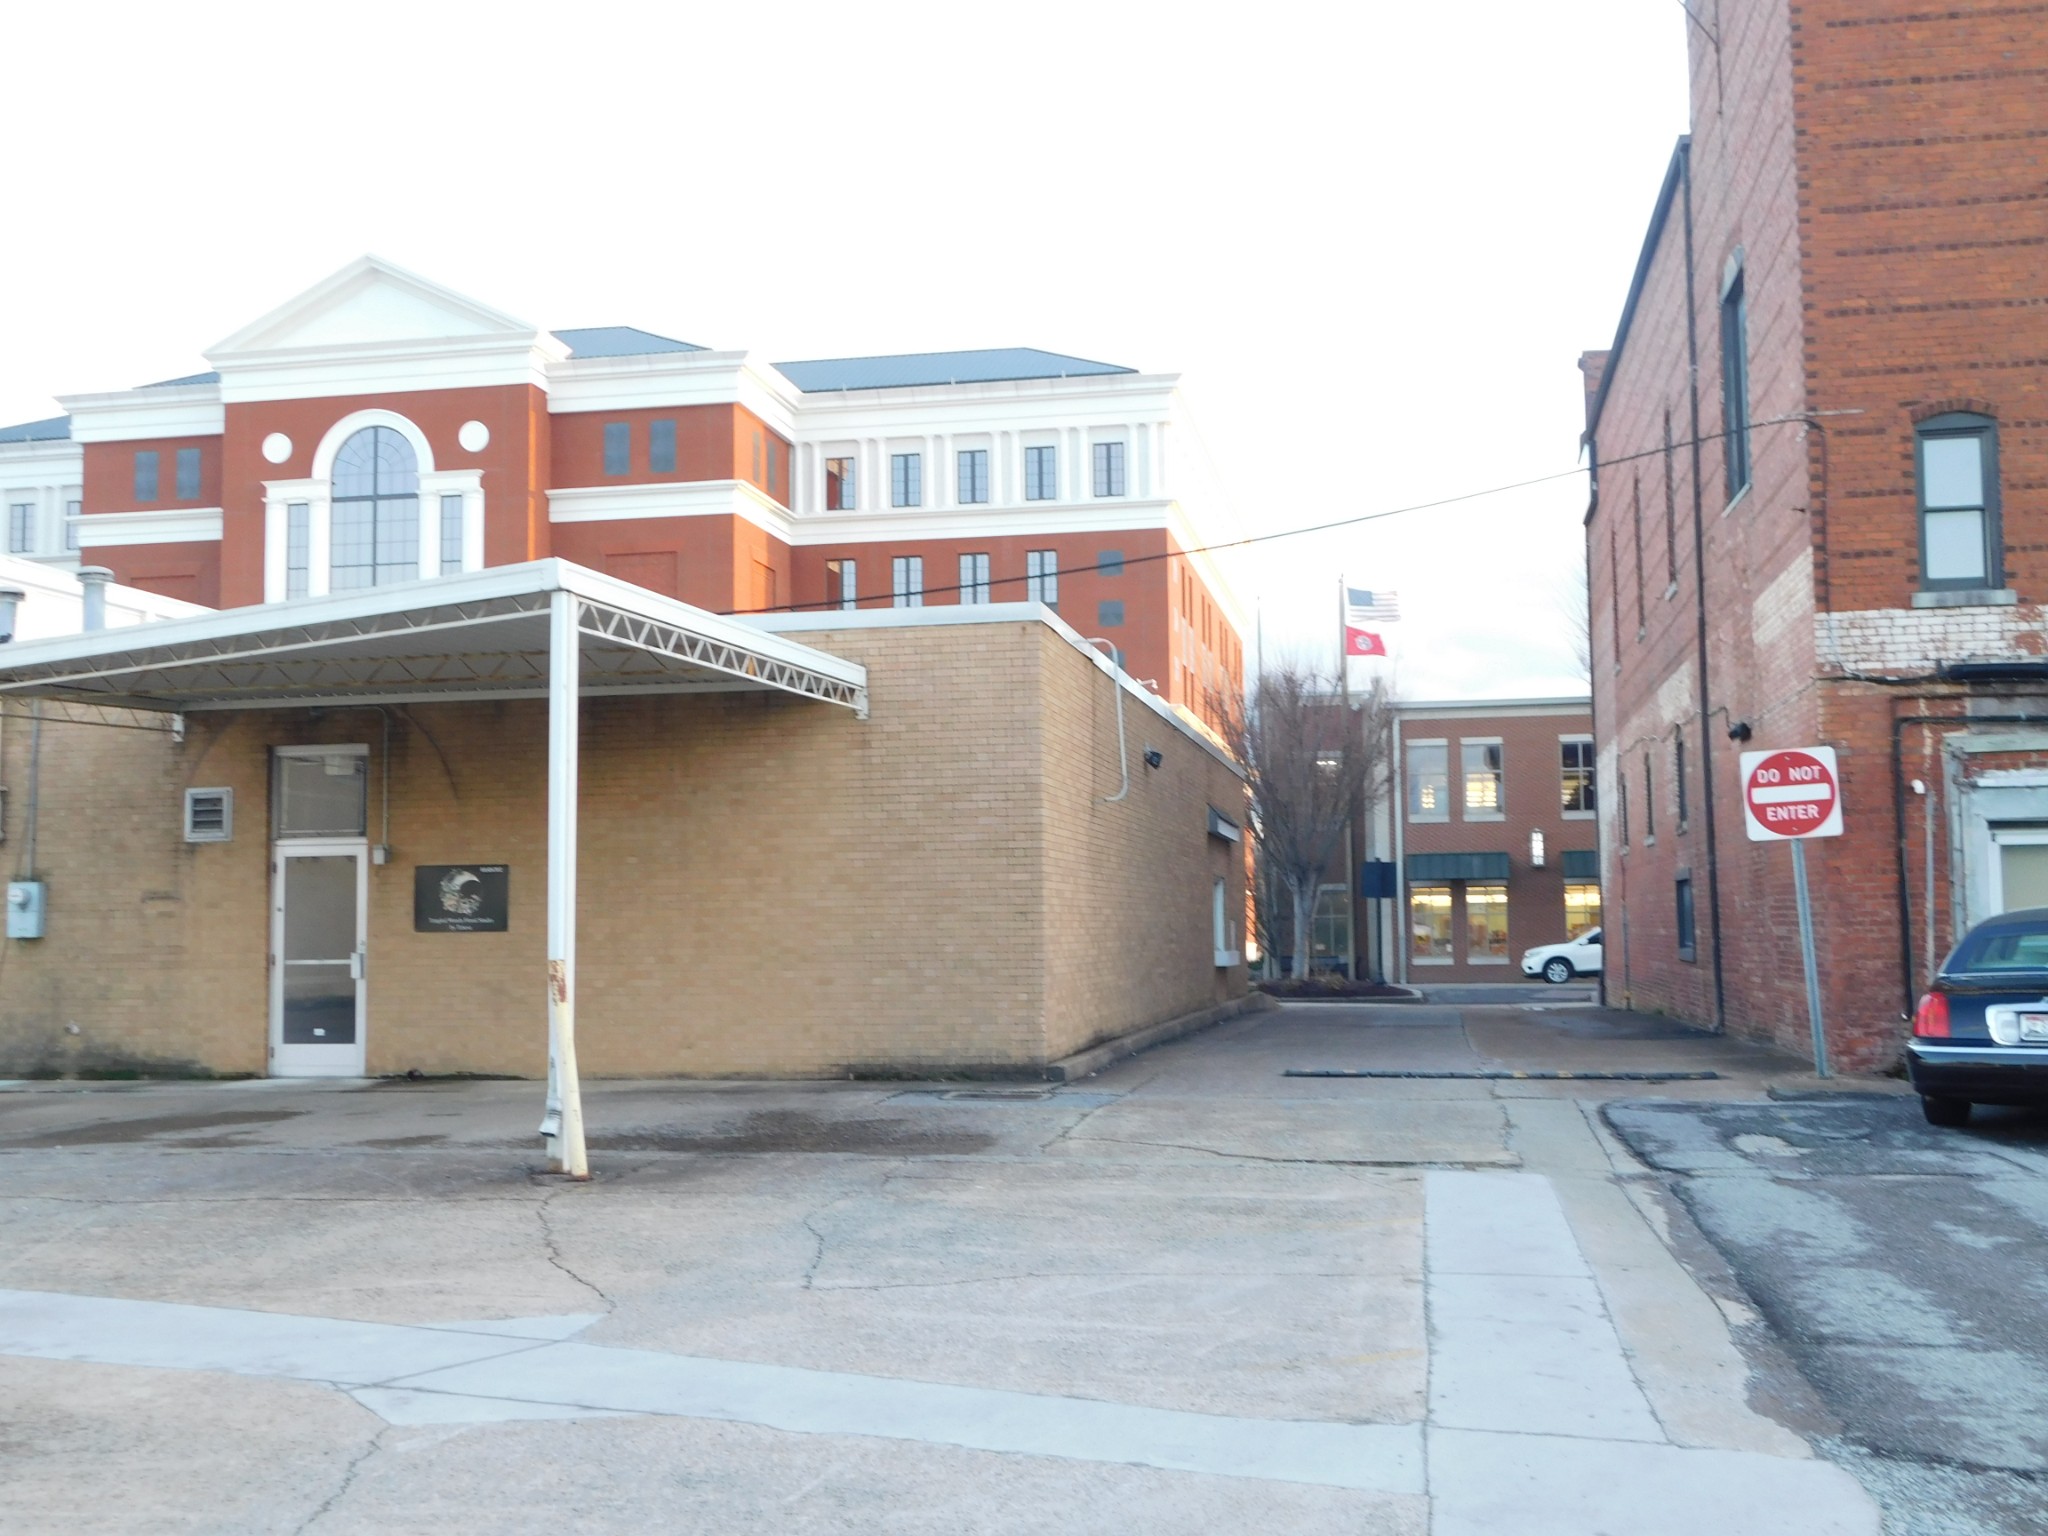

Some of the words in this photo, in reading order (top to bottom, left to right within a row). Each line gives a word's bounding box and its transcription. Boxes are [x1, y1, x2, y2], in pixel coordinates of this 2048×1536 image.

[1756, 768, 1781, 783] DO
[1788, 765, 1822, 781] NOT
[1766, 804, 1820, 821] ENTER
